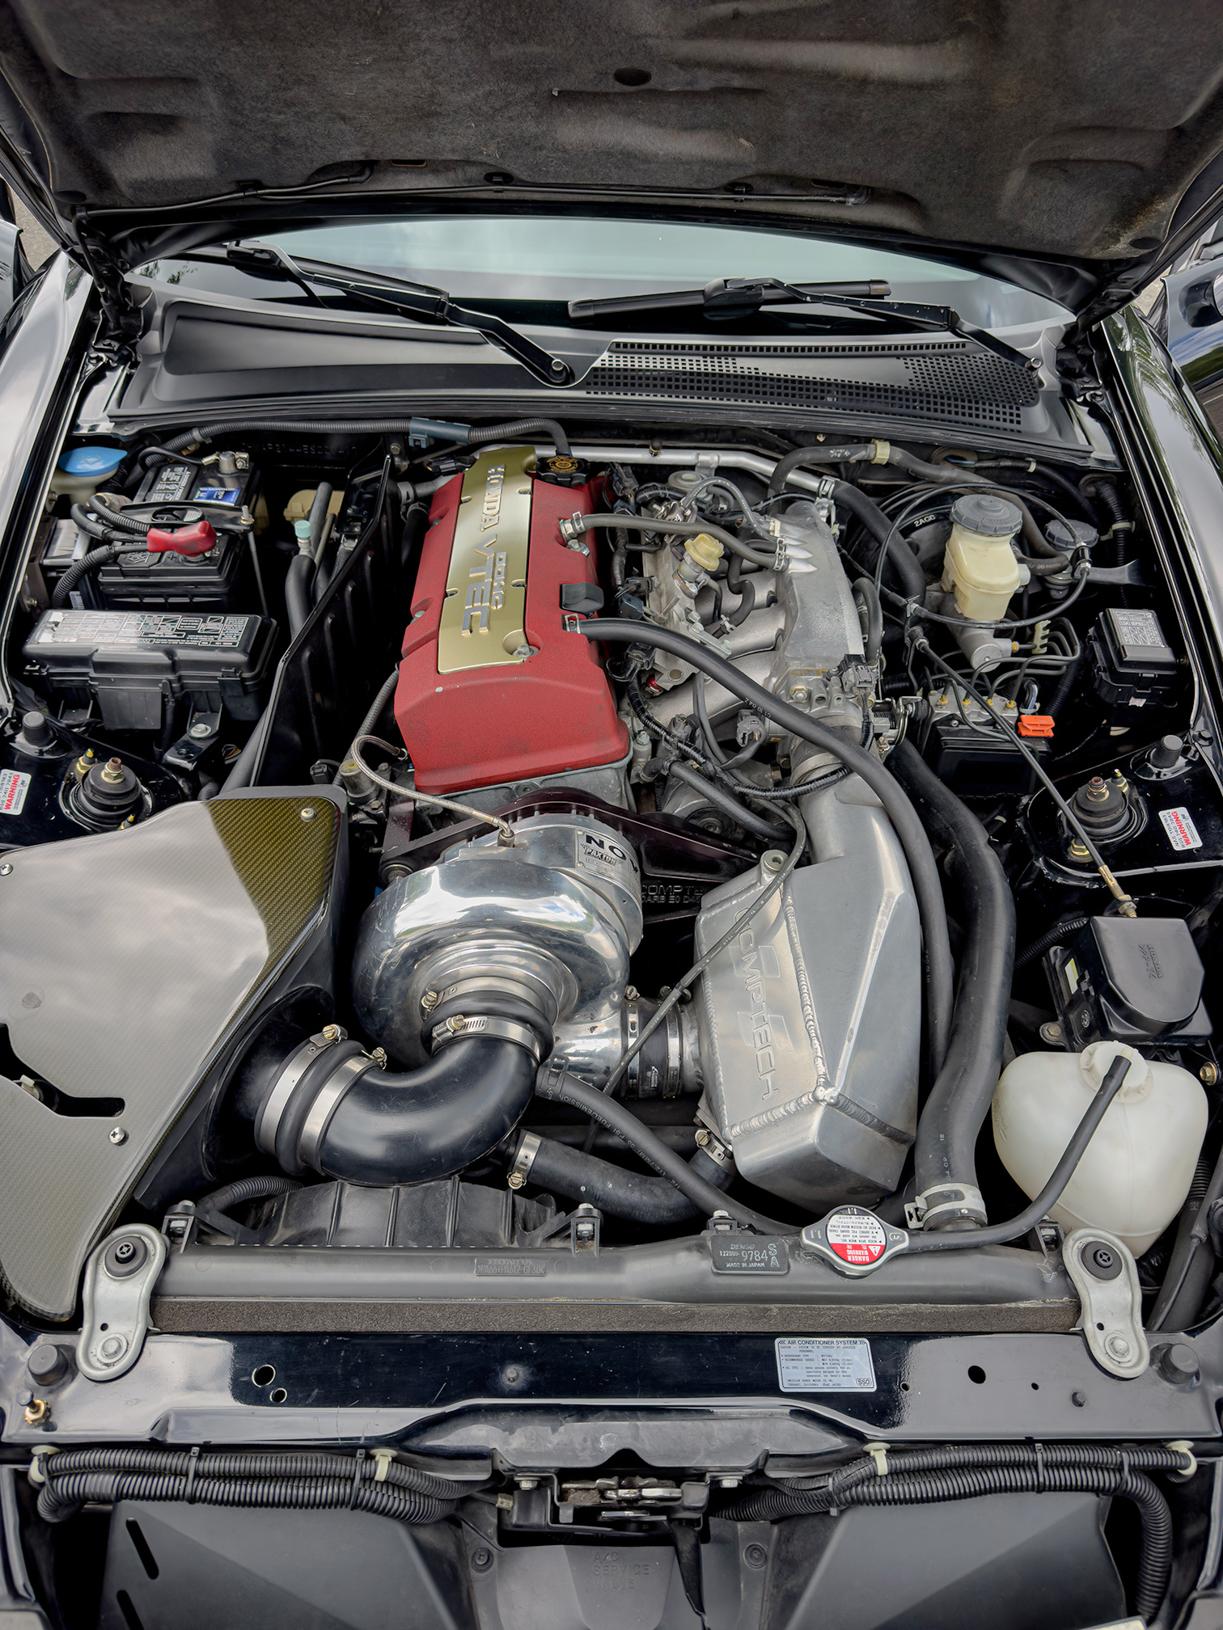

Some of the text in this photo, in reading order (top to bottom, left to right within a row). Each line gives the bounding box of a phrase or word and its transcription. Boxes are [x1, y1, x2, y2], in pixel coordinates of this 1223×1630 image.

[480, 464, 506, 533] HONDA
[461, 534, 497, 636] VTEC
[491, 551, 507, 610] DOHC
[4, 774, 20, 810] WARNING
[1171, 811, 1192, 846] WARNING
[741, 1249, 768, 1262] 9784
